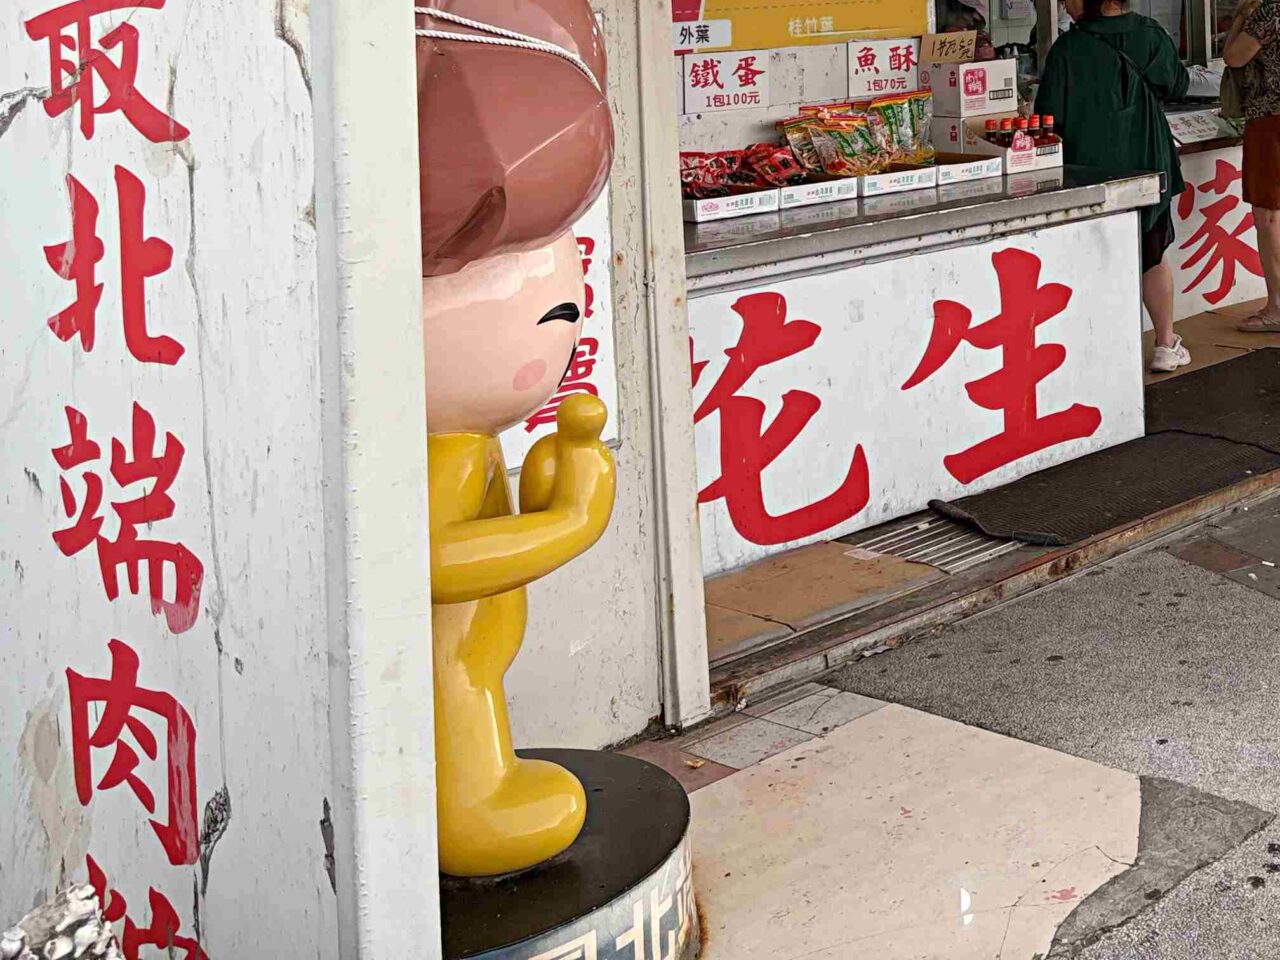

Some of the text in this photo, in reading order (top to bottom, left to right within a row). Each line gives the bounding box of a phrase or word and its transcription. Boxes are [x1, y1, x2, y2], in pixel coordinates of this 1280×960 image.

[680, 25, 710, 46] 外葉
[788, 16, 834, 38] 桂竹葉
[688, 56, 766, 89] 鐵蛋
[854, 44, 918, 75] 魚酥
[866, 77, 908, 92] 1包70元
[705, 91, 761, 108] 1包100元
[1177, 158, 1265, 305] 家
[690, 291, 1102, 546] 花生
